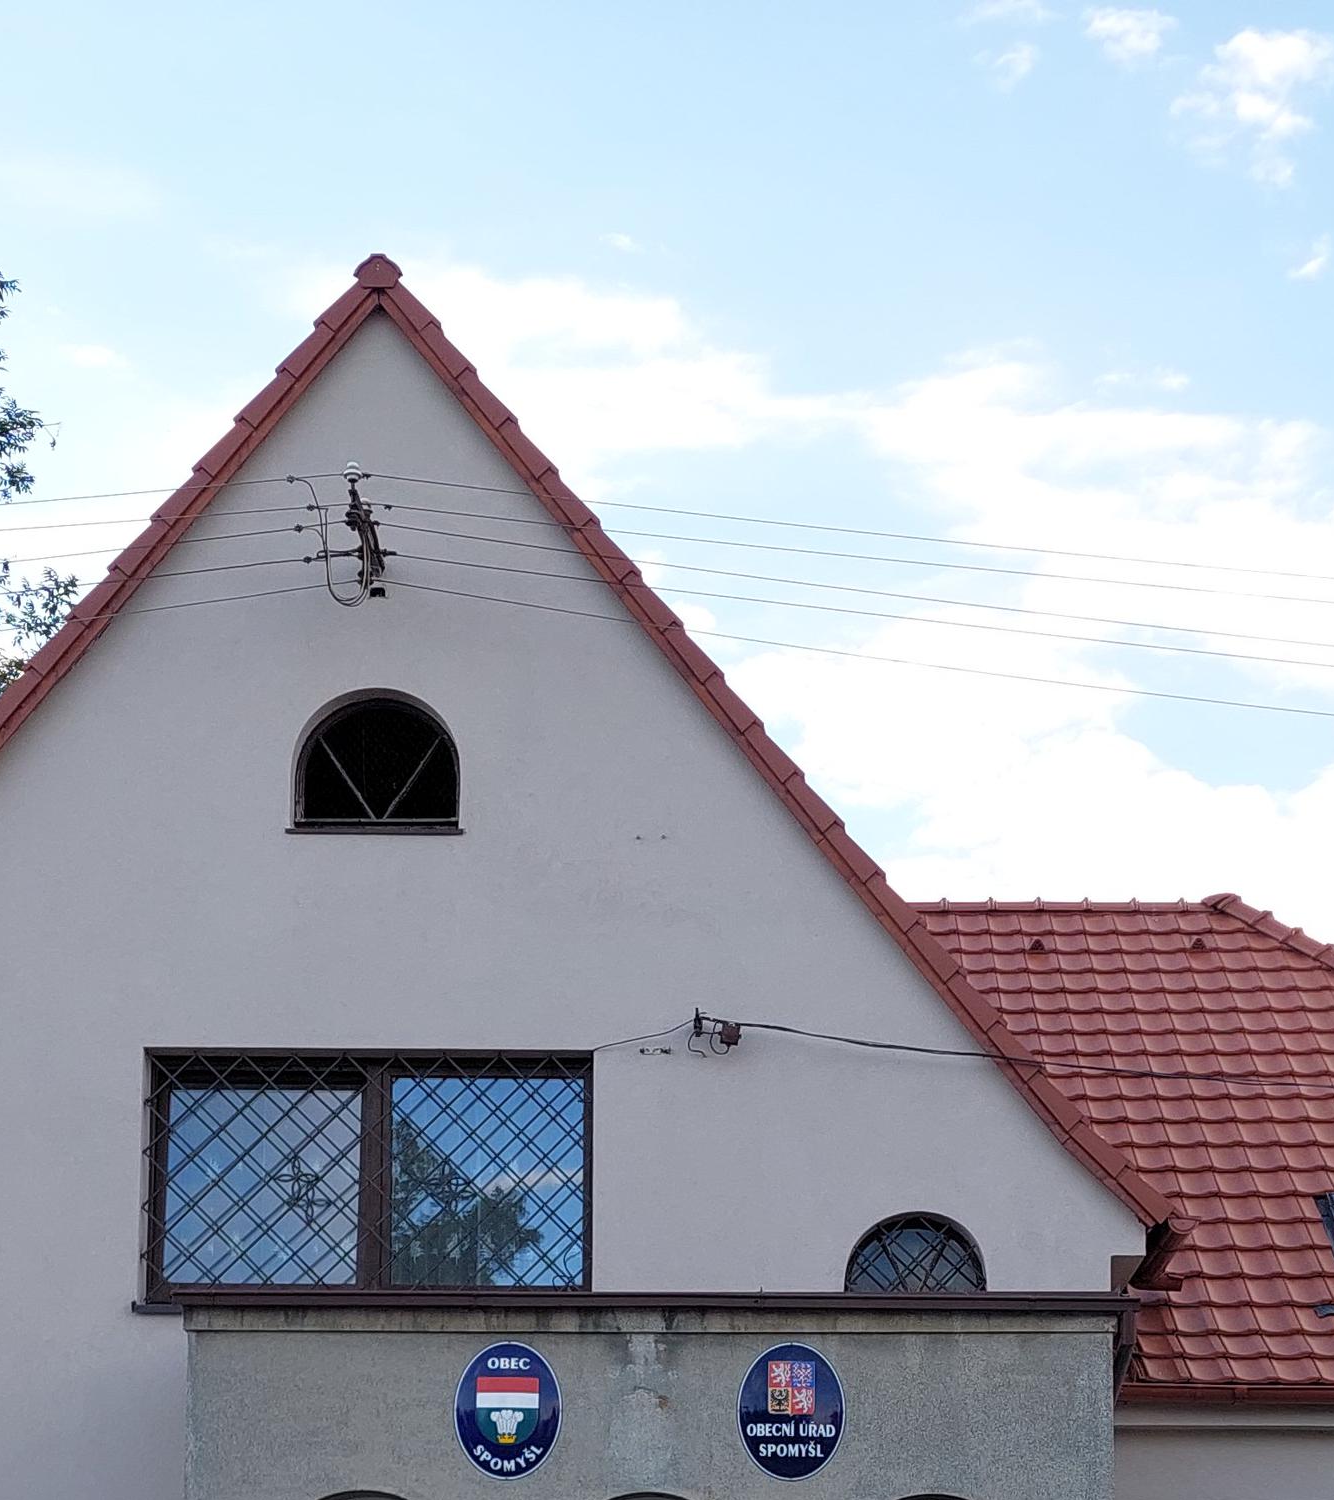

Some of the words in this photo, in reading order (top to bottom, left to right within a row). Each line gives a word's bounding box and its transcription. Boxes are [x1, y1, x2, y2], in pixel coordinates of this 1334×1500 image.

[487, 1357, 531, 1370] OBEC
[747, 1420, 795, 1437] OBECNÍ
[799, 1420, 836, 1438] ÚŘAD
[759, 1440, 824, 1457] SPOMYŠL
[473, 1444, 544, 1472] SPOMYŠL
